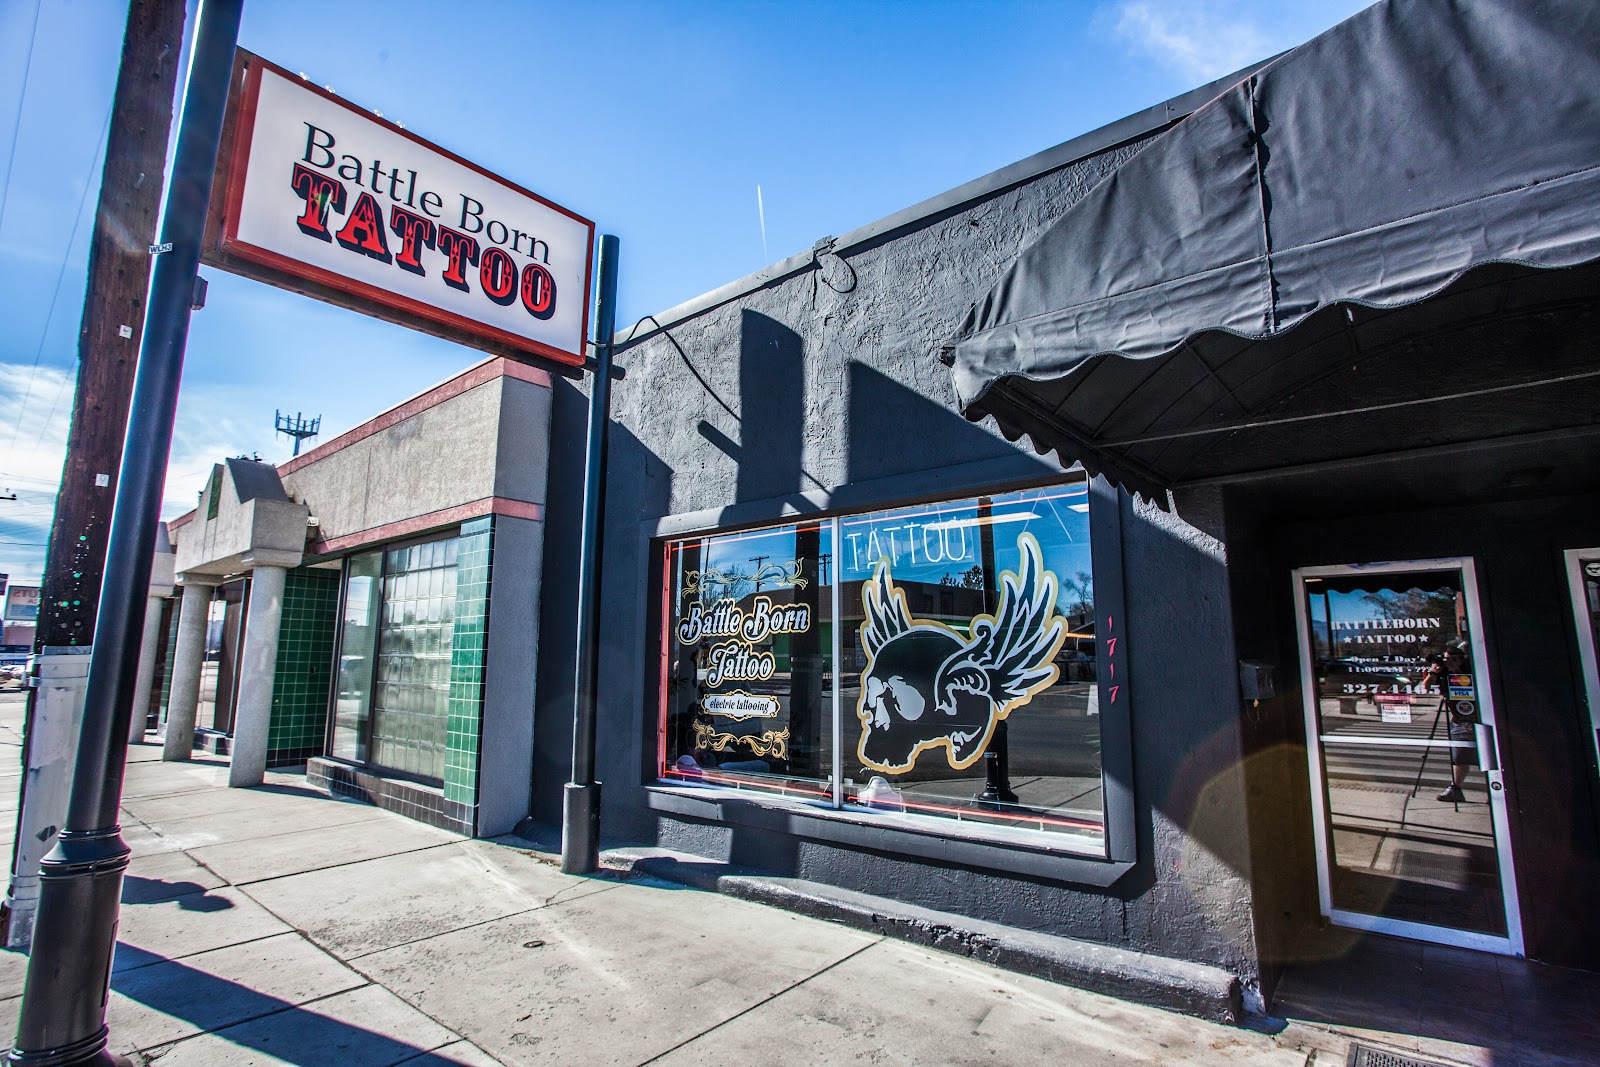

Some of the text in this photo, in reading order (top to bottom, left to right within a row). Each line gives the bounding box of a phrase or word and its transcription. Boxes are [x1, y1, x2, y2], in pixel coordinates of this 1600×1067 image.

[301, 121, 551, 265] Battle Born
[290, 161, 557, 321] TATTOO
[847, 519, 966, 572] TATTOO
[678, 598, 809, 644] Battle Born
[1331, 617, 1440, 630] BATTLEBORN
[1354, 634, 1416, 644] TATTOO
[707, 642, 774, 687] Tattoo
[1106, 615, 1119, 705] 1717
[1350, 656, 1379, 664] Open
[1394, 655, 1426, 664] Day's
[709, 699, 769, 714] electric tattooing
[1343, 683, 1440, 694] 327.4465
